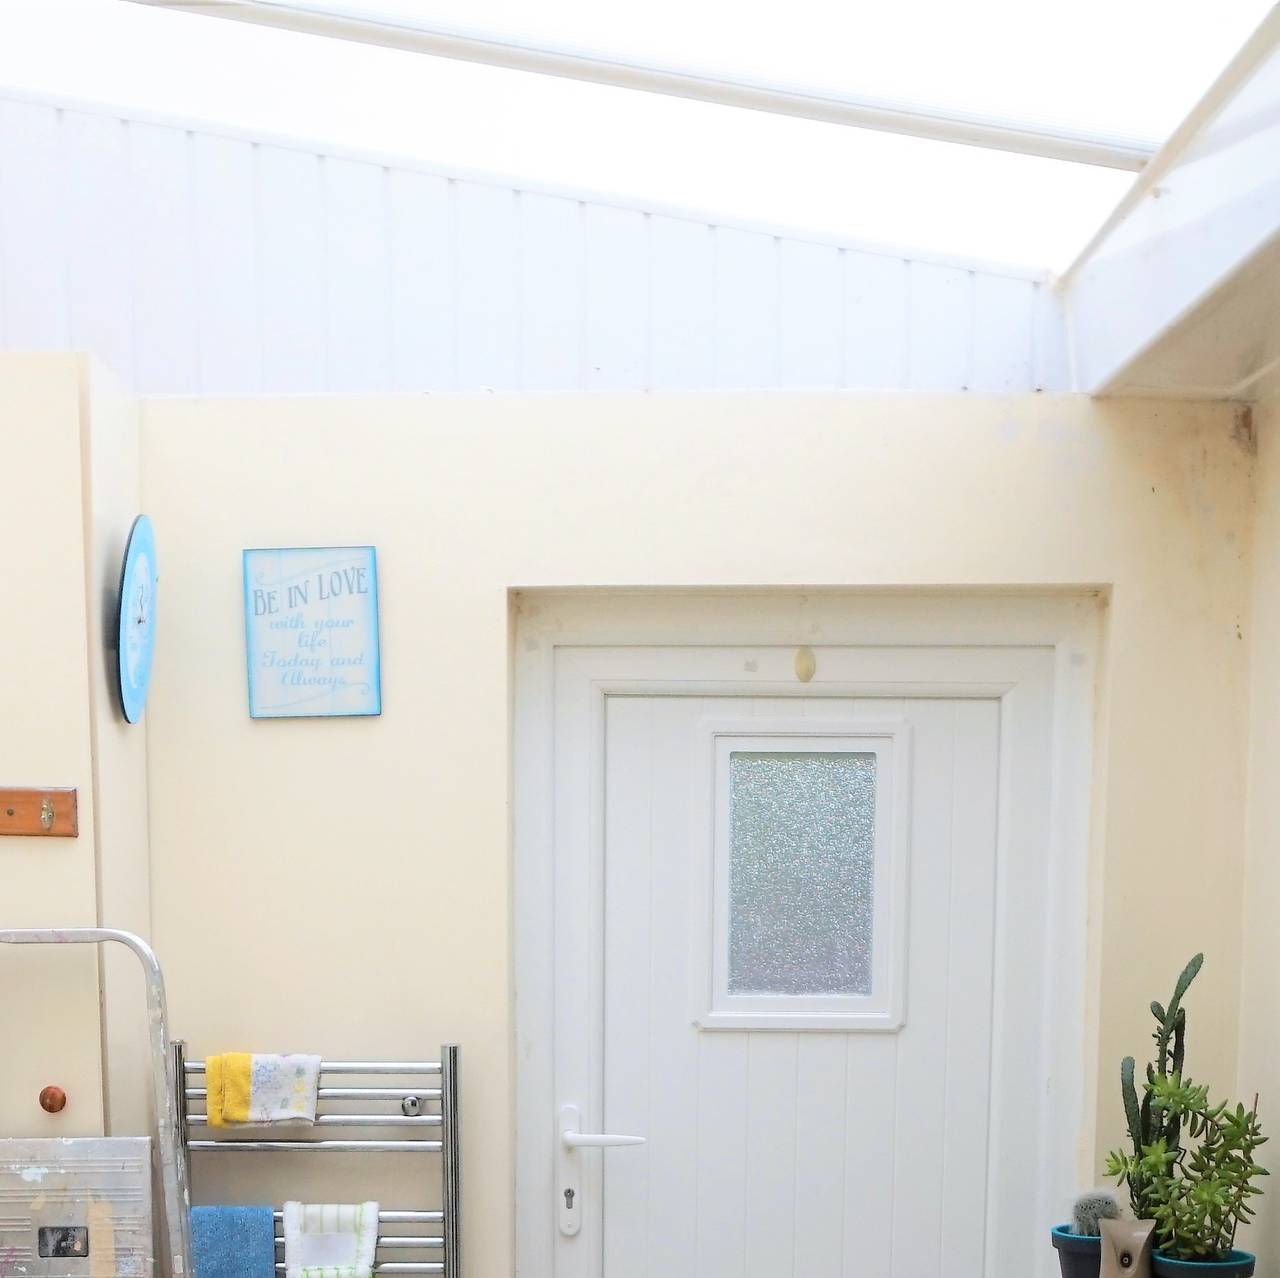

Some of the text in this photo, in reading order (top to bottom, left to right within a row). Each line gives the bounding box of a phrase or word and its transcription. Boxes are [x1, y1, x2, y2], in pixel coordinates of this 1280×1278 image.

[253, 566, 369, 617] BE IN LOVE
[269, 611, 355, 635] with your
[297, 630, 329, 653] life
[261, 650, 366, 671] Today and
[280, 670, 348, 690] Always
